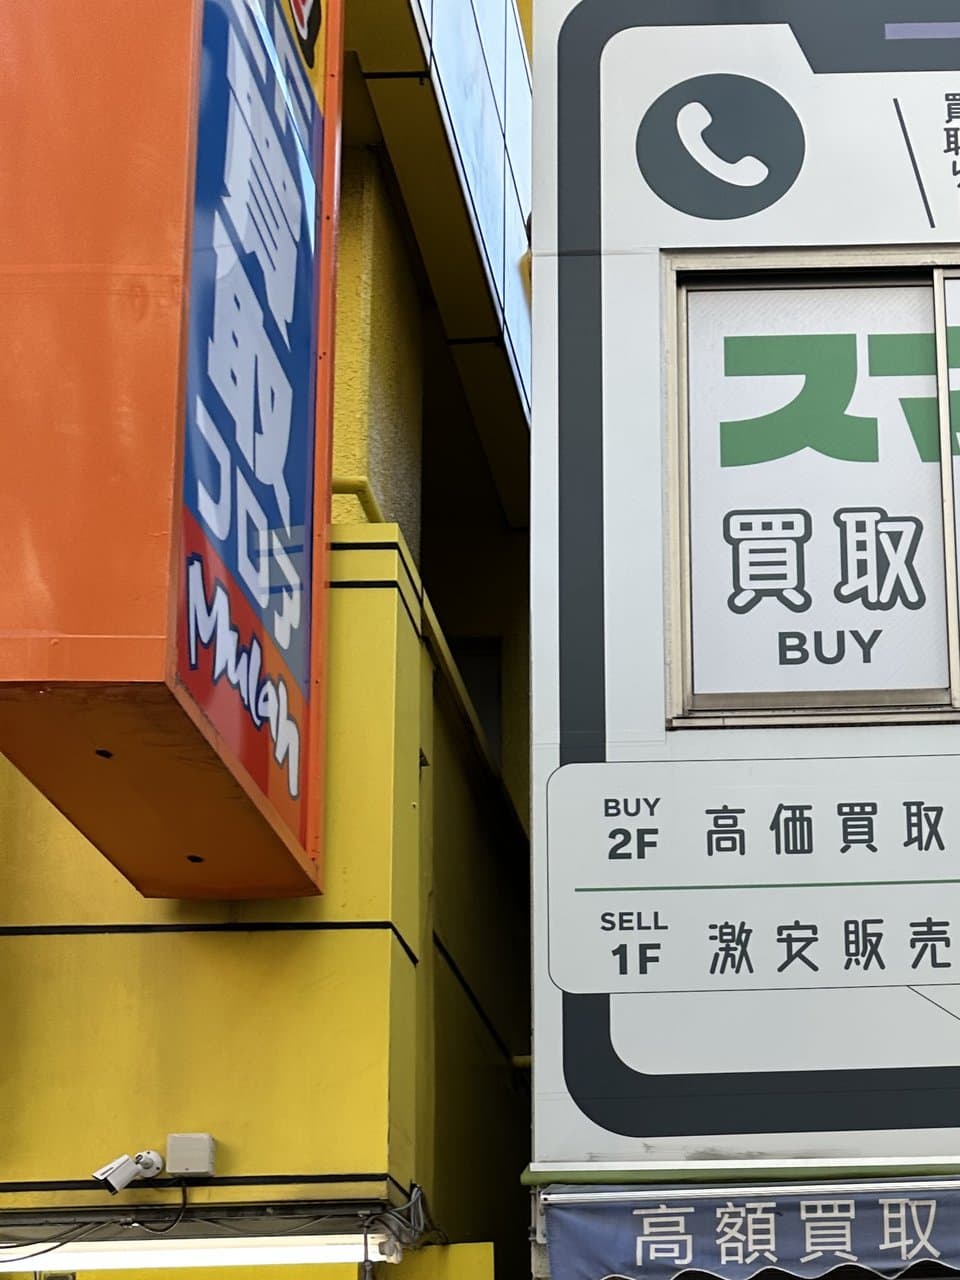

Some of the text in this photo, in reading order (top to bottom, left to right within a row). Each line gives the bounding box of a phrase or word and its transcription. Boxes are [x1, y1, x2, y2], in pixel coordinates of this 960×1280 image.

[722, 507, 927, 615] 買取
[778, 629, 883, 666] BUY
[603, 797, 661, 817] BUY
[608, 828, 660, 860] 2F
[705, 801, 945, 856] 高価買取
[600, 911, 669, 931] SELL
[611, 943, 662, 975] 1F
[708, 916, 952, 975] 激安販売
[632, 1198, 944, 1266] 高額買取
